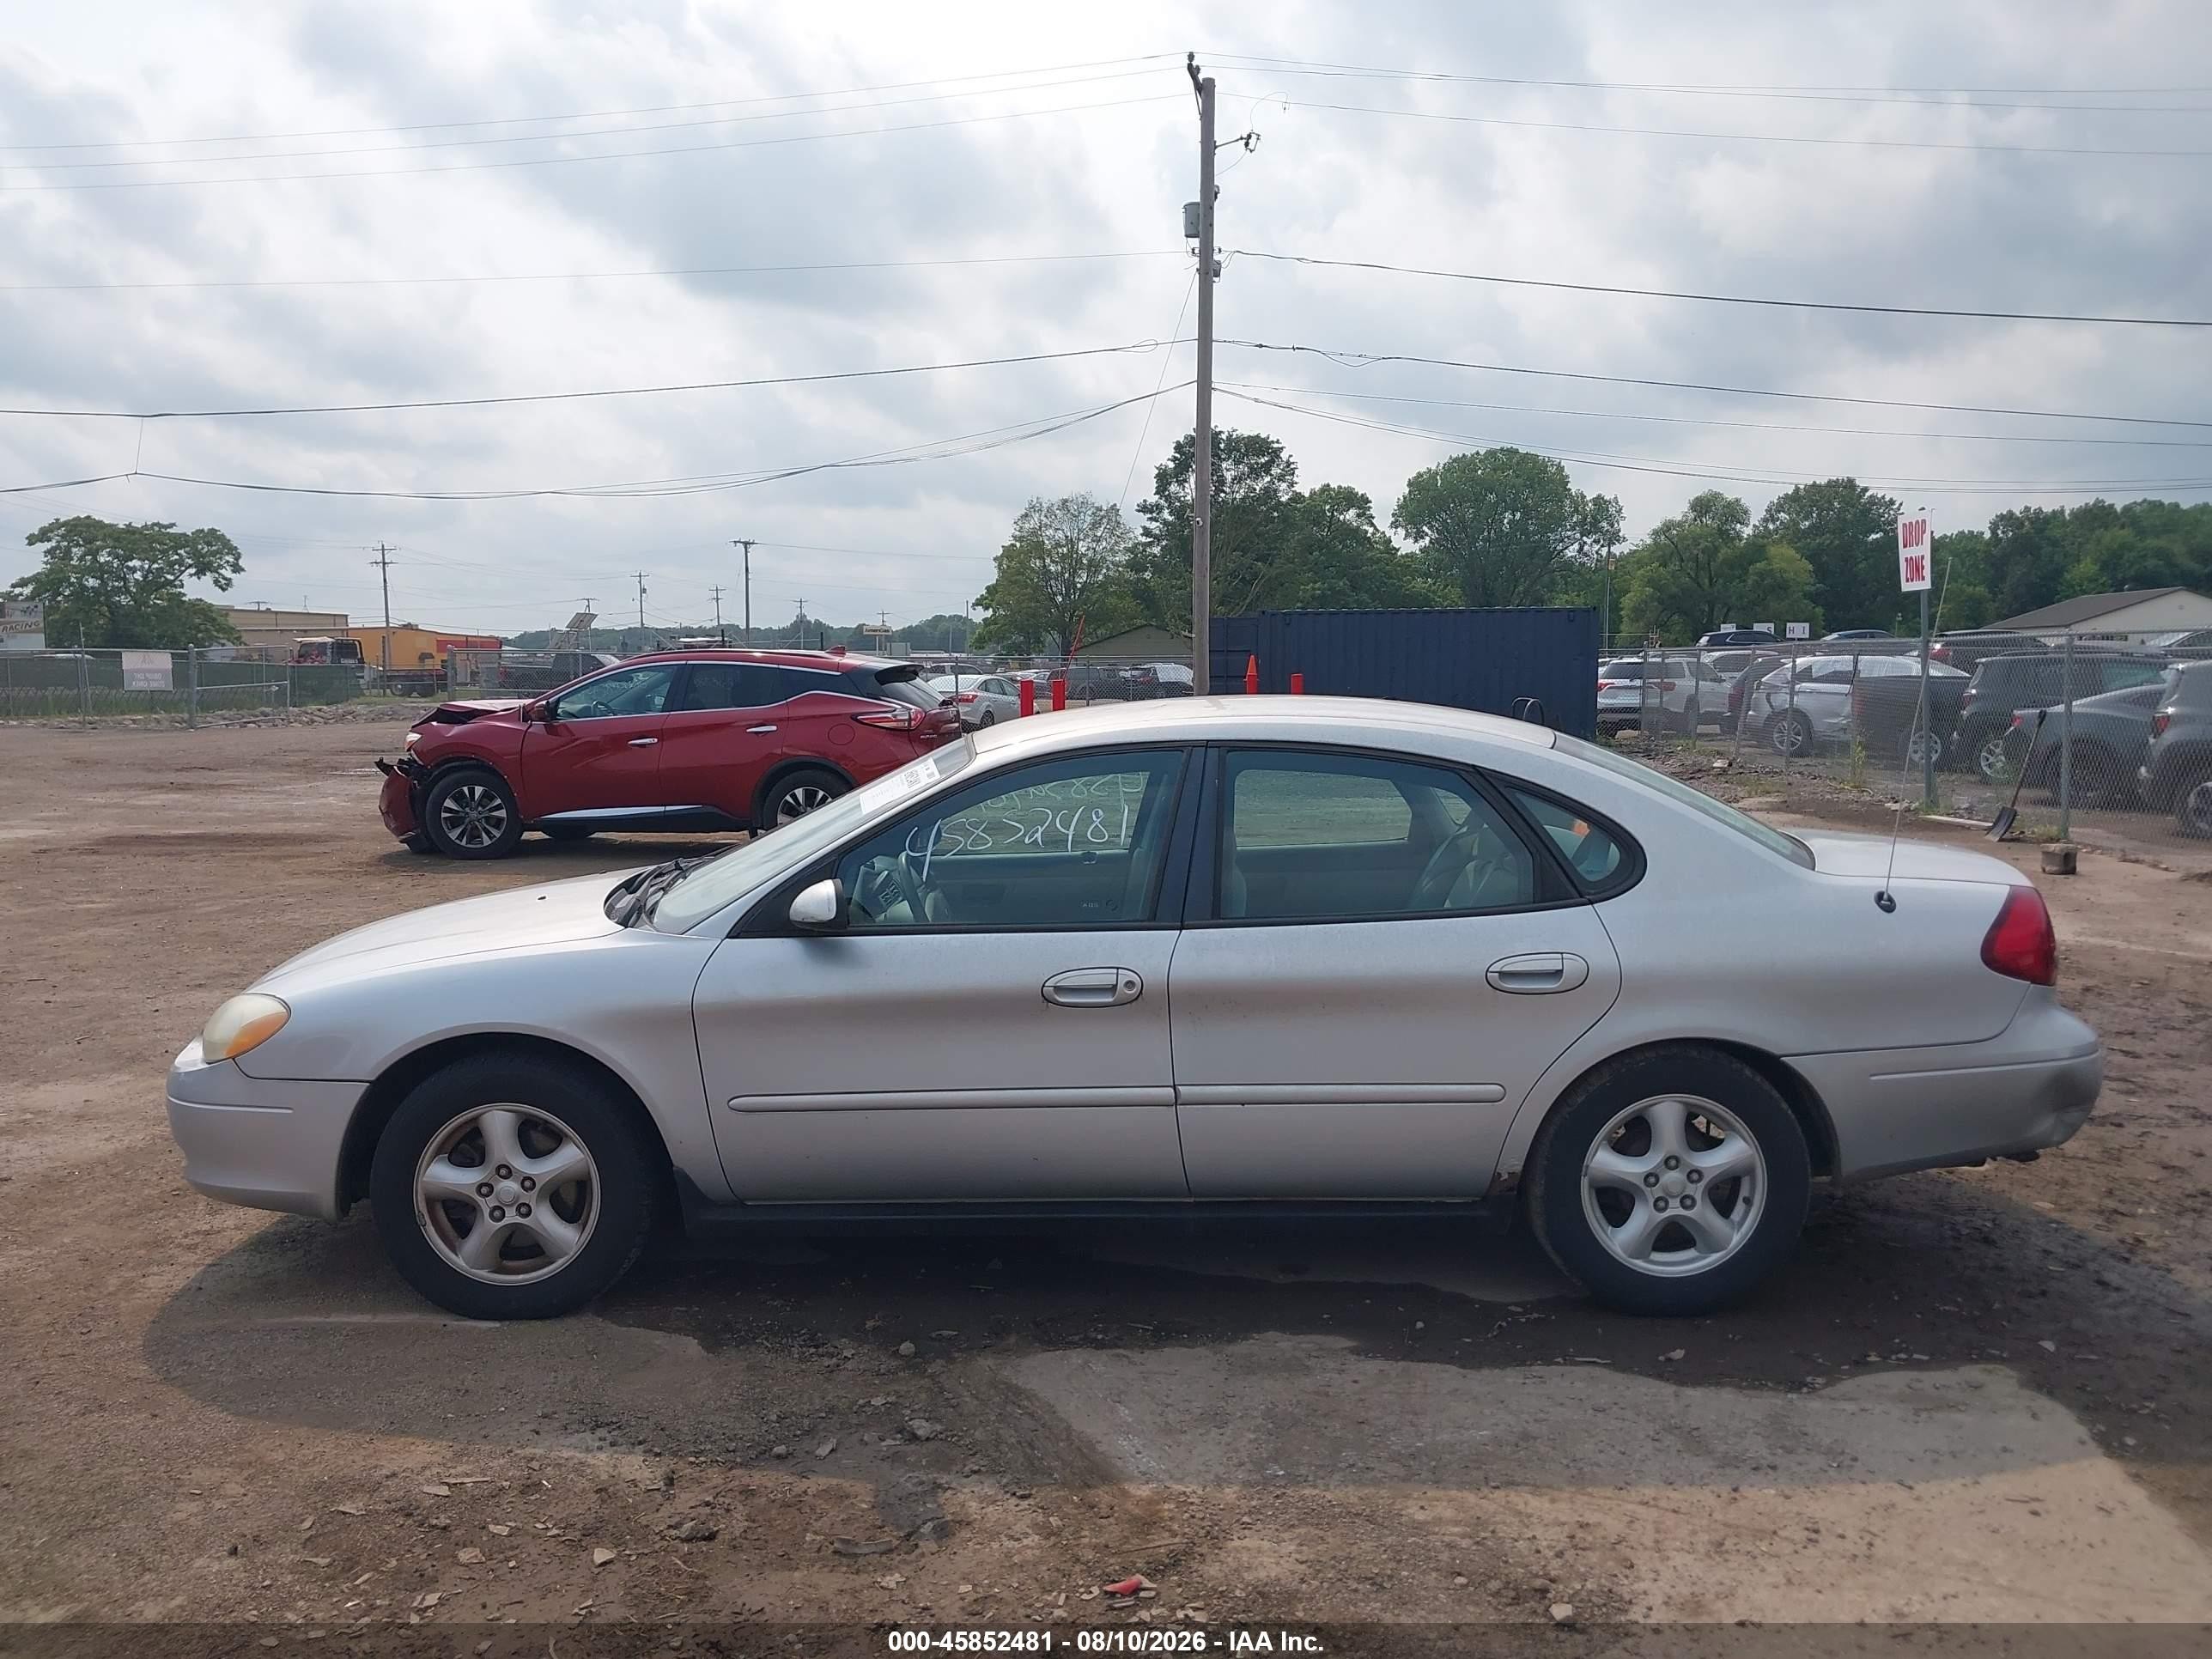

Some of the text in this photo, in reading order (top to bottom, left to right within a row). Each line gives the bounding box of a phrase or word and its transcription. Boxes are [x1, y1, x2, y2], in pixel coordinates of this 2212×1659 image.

[1901, 519, 1927, 549] DROP
[1904, 554, 1926, 583] ZONE
[2, 620, 40, 633] RACING
[905, 804, 1129, 883] 45852481
